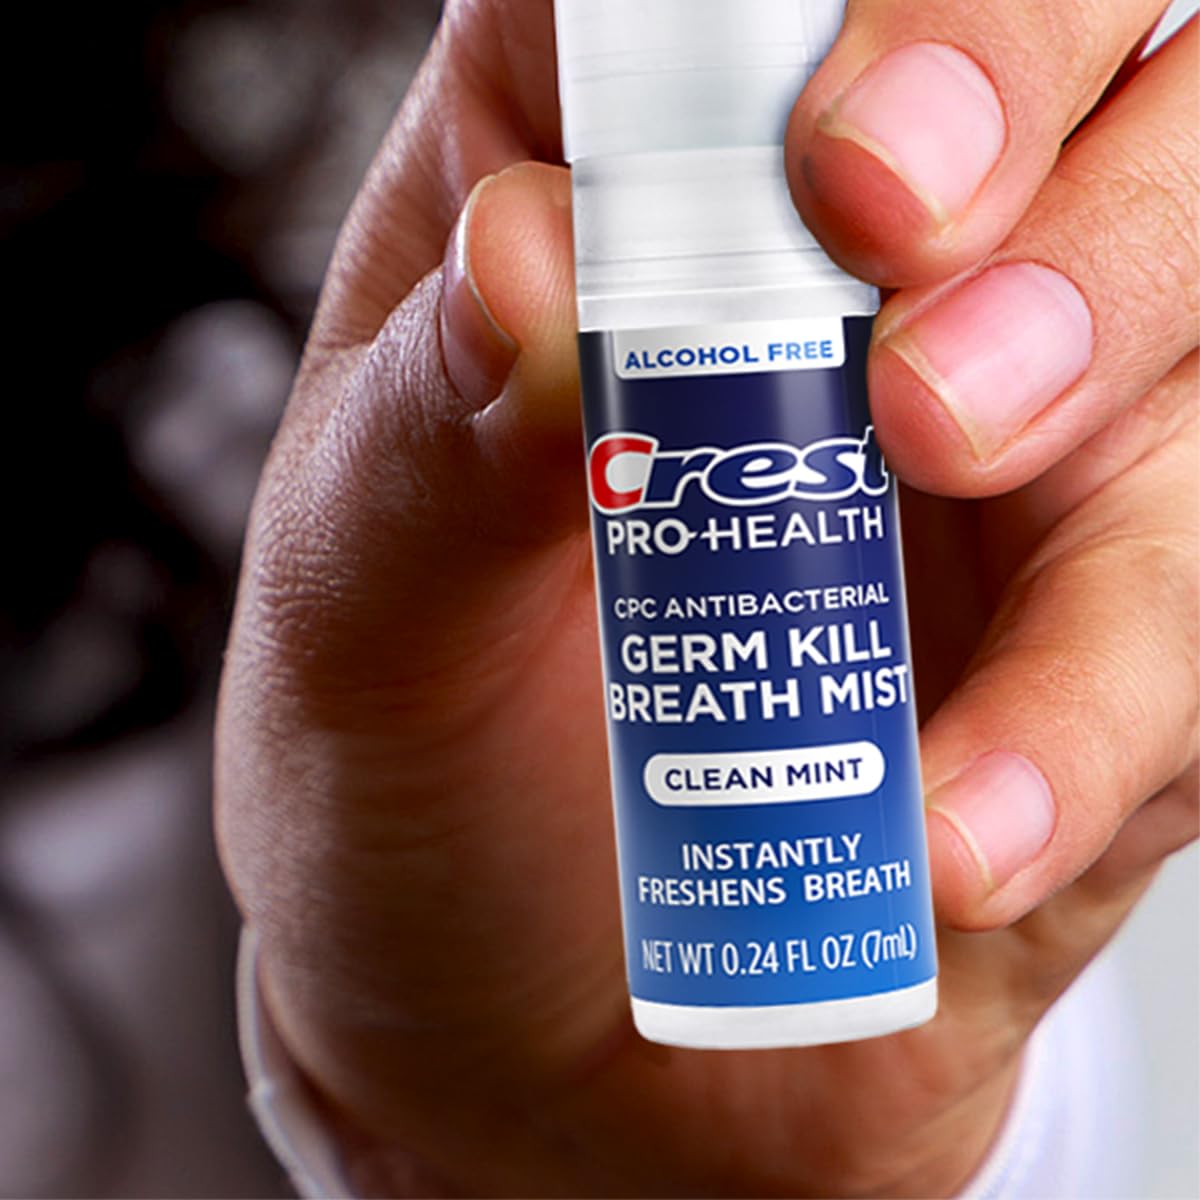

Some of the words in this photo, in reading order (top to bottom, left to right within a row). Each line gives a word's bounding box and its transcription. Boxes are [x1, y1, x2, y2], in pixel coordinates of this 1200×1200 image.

[625, 347, 758, 369] ALCOHOL
[768, 341, 832, 360] FREE
[590, 426, 888, 513] Crest
[615, 597, 657, 619] CPC
[665, 583, 888, 618] ANTIBACTERIAL
[622, 632, 767, 673] GERM
[789, 621, 890, 667] KILL
[611, 680, 799, 721] BREATH
[822, 666, 906, 713] MIST
[665, 767, 772, 790] CLEAN
[788, 758, 861, 785] MINT
[683, 834, 861, 869] INSTANTLY
[639, 878, 785, 905] FRESHENS
[804, 862, 910, 900] BREATH
[643, 940, 672, 972] NET
[679, 944, 714, 974] WT
[722, 943, 778, 975] 0.24
[788, 941, 816, 972] FL
[822, 935, 855, 967] OZ
